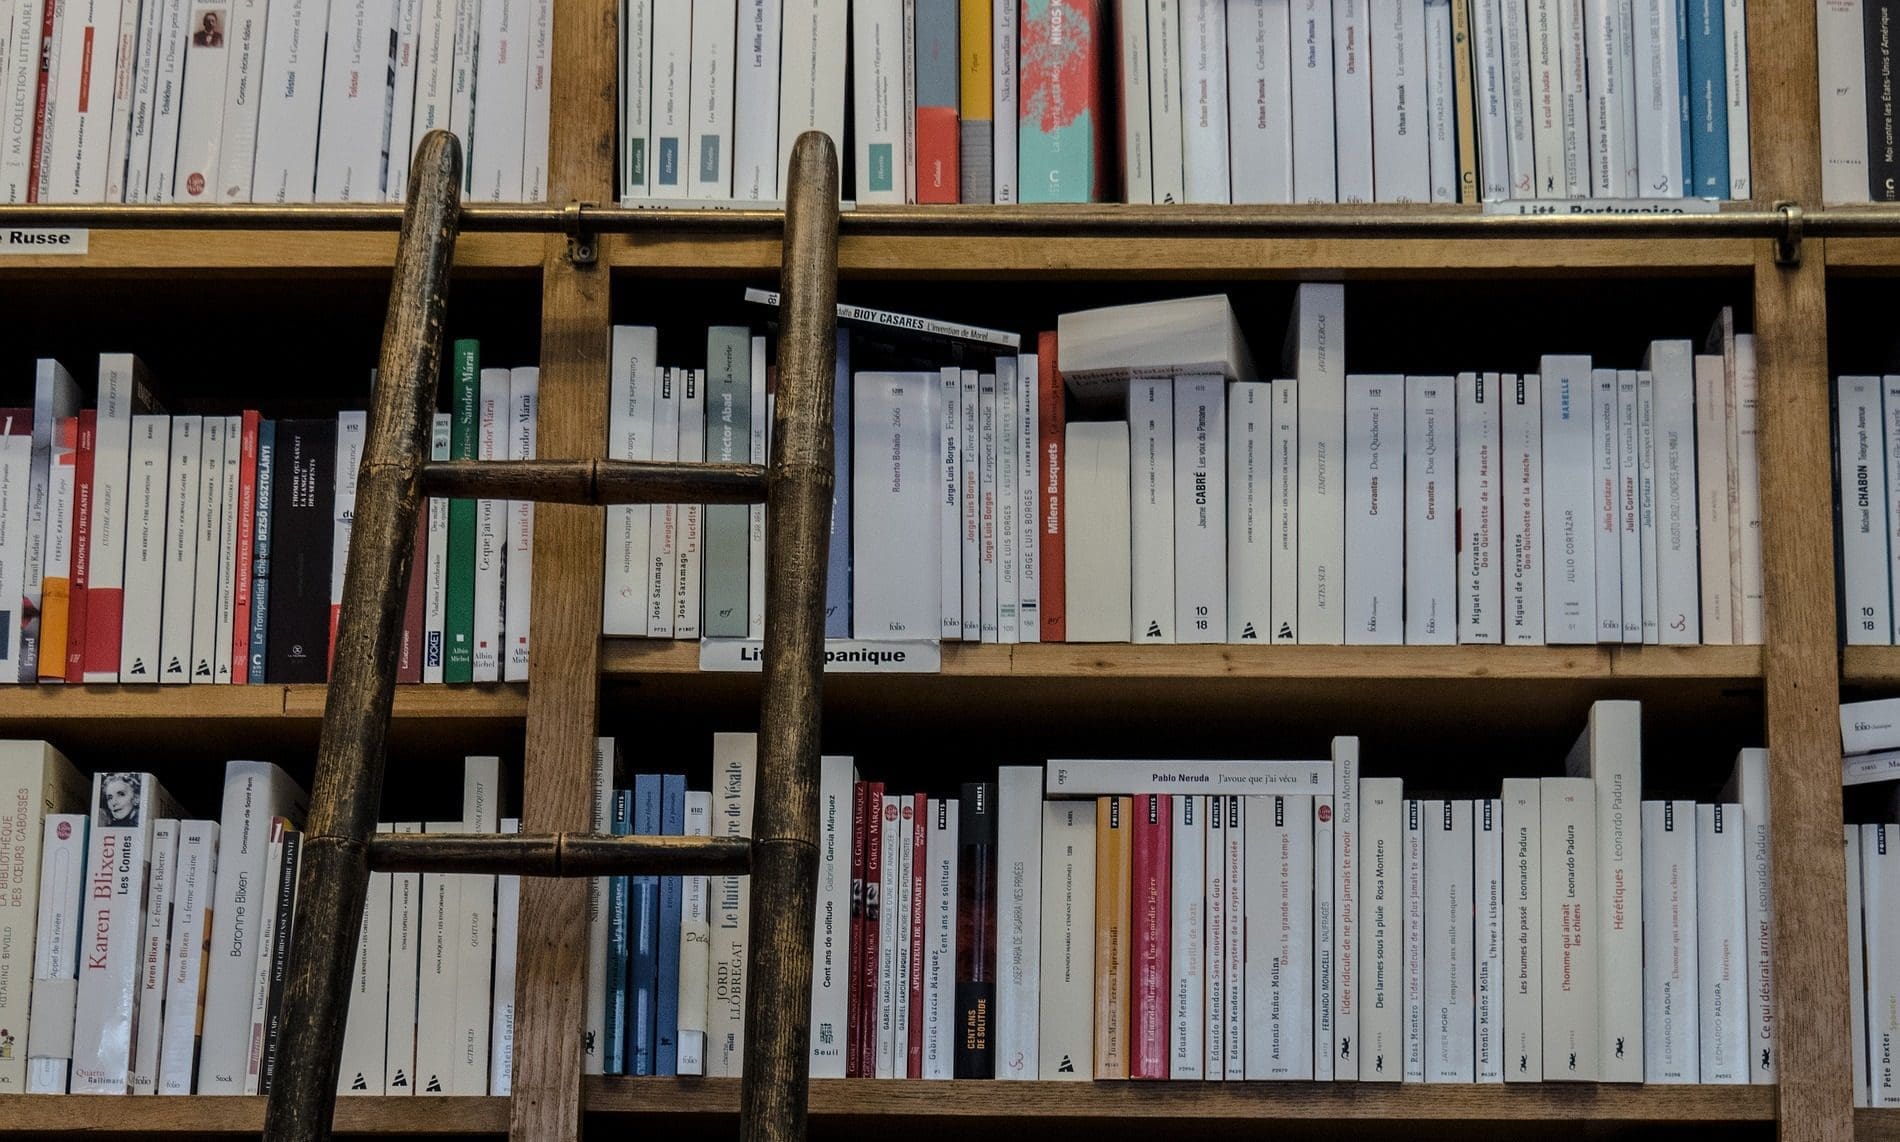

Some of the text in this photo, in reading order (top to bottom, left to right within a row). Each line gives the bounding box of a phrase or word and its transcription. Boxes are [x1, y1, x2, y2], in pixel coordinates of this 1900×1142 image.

[1051, 9, 1061, 44] NIKOS
[12, 3, 33, 154] MA COLLECTION LITTÉRAIRE
[1880, 7, 1894, 162] Moi contre les États-Unis d'Amérique
[1257, 78, 1266, 129] Orhan Pamuk
[10, 231, 70, 244] Russe
[853, 308, 925, 329] BIOY CASARES
[1318, 315, 1326, 373] JAVIER CERCAS
[462, 352, 474, 424] Sándor Márai
[1560, 378, 1570, 420] MARELLE
[721, 393, 733, 462] Héctor Abad
[1196, 405, 1206, 432] Pamano
[1369, 412, 1380, 452] Quichotte
[892, 408, 902, 493] Roberto Bolaño 2666
[945, 400, 956, 506] Jorge Luis Borges Fictions
[1197, 456, 1206, 469] Les
[1198, 443, 1206, 455] voix
[1318, 441, 1326, 495] L'IMPOSTEUR
[1369, 453, 1378, 470] Don
[1856, 406, 1870, 533] Michael CHABON Telegraph Avenue
[258, 444, 271, 509] KOSZTOLÁNYI
[1046, 443, 1059, 534] Milena Busquets
[1195, 472, 1207, 505] CABRÉ
[1197, 507, 1207, 529] Jaume
[1480, 445, 1489, 568] Don Quichotte de la Manche
[76, 483, 89, 575] DÉNONCE L'HUMANITÉ
[1024, 489, 1033, 581] JORGE LUIS BORGES
[1563, 510, 1575, 583] JULIO CORTÁZAR
[256, 543, 268, 578] tchèque
[1318, 565, 1326, 583] SUD
[1471, 532, 1481, 624] Miguel de Cervantes
[255, 578, 266, 632] Trompettiste
[652, 557, 664, 619] José Saramago
[1196, 606, 1208, 615] 10
[1196, 620, 1208, 630] 18
[1862, 607, 1874, 616] 10
[1862, 621, 1874, 630] 18
[24, 638, 37, 667] Fayard
[255, 633, 264, 644] Le
[725, 762, 742, 819] de Vésale
[1152, 773, 1298, 784] Pablo Neruda J'avoue que j'ai vécu
[826, 795, 836, 832] Márquez
[12, 788, 29, 907] DES CŒURS CABOSSÉS
[118, 835, 132, 895] Les Contes
[1376, 839, 1384, 878] Montero
[1566, 825, 1575, 898] Leonardo Padura
[1612, 774, 1625, 930] Hérétiques Leonardo Padura
[825, 864, 835, 892] Gabriel
[1341, 760, 1352, 1015] L'idée ridicule de ne plus jamais te revoir Rosa Montero
[1375, 880, 1384, 900] Rosa
[89, 835, 115, 970] Karen Blixen
[230, 871, 248, 957] Baronne Blixen
[824, 901, 833, 934] solitude
[1375, 906, 1385, 928] pluie
[1572, 904, 1581, 946] les chiens
[1756, 824, 1771, 1039] Ce qui désirait arriver Leonardo Padura
[824, 949, 832, 966] ans
[1376, 939, 1384, 959] sous
[1562, 904, 1572, 991] L'homme qui aimait
[717, 961, 729, 1002] JORDI
[729, 942, 742, 1020] LLOBREGAT
[823, 968, 832, 988] Cent
[1375, 961, 1384, 990] larmes
[1271, 957, 1280, 1060] Antonio Muñoz Molina
[1375, 992, 1384, 1008] Des
[967, 1010, 976, 1049] CENT ANS
[976, 998, 986, 1049] DE SOLITUDE
[1882, 1033, 1892, 1088] Pete Dexter
